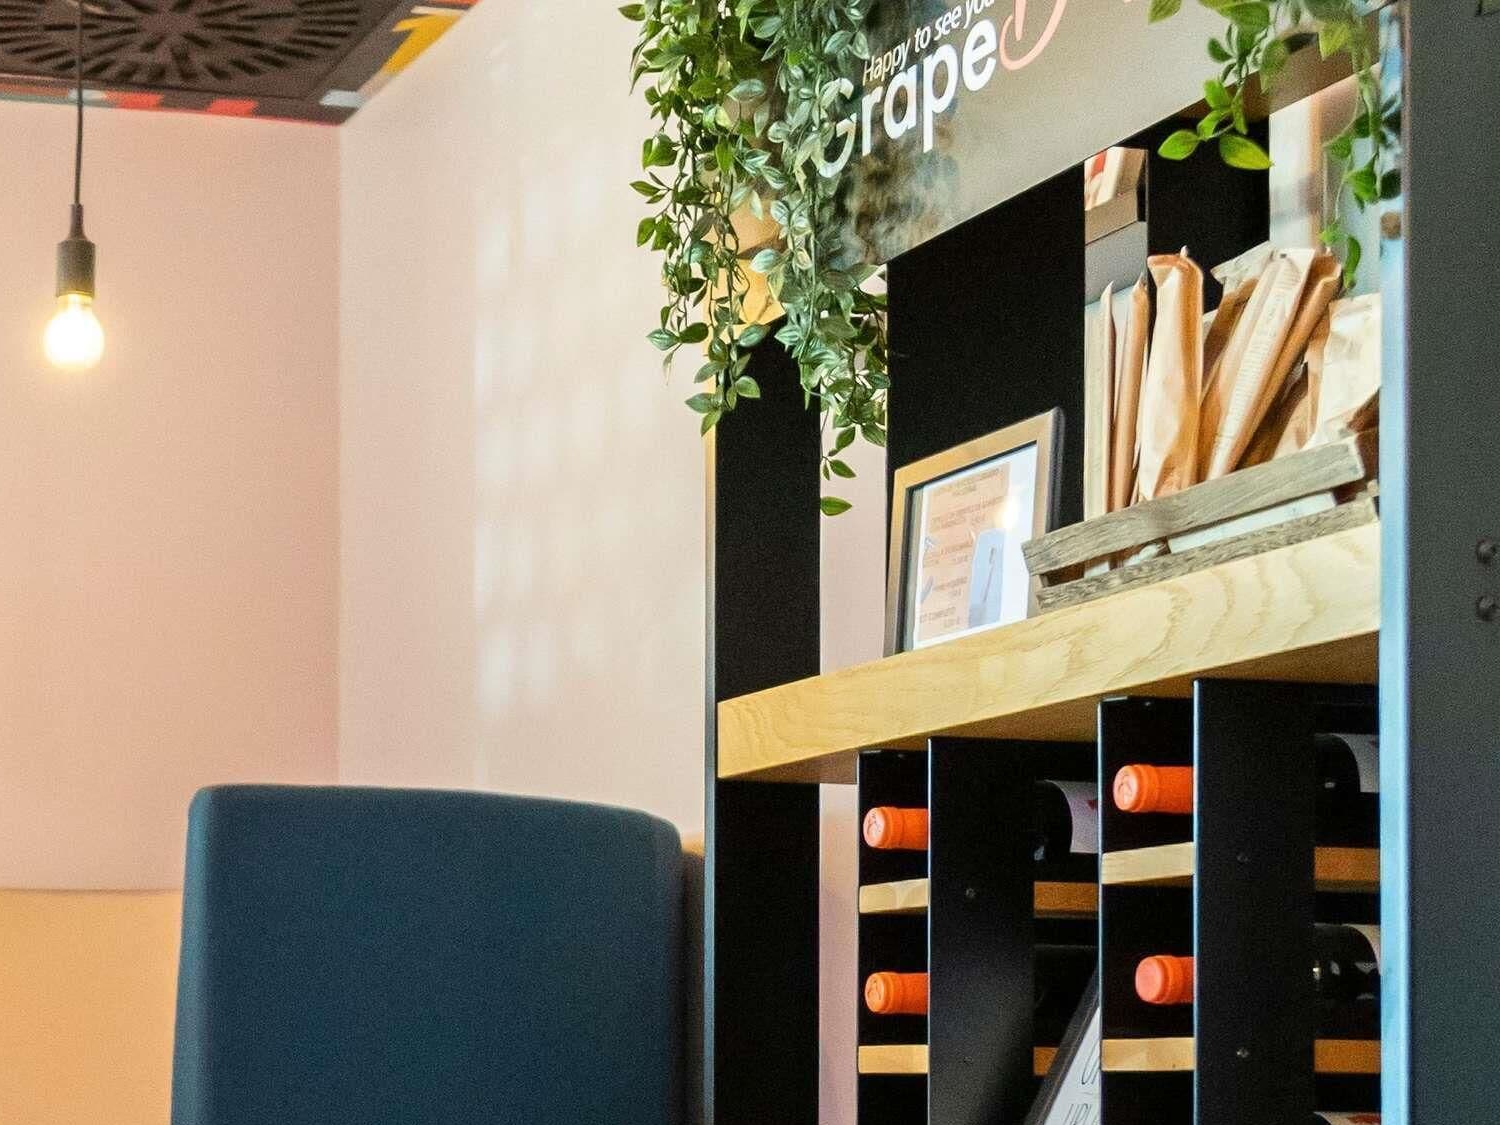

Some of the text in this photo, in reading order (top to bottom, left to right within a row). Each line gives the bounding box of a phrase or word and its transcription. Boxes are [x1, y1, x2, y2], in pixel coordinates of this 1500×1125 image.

[862, 37, 911, 86] Happy
[914, 25, 931, 53] to
[933, 5, 961, 41] see
